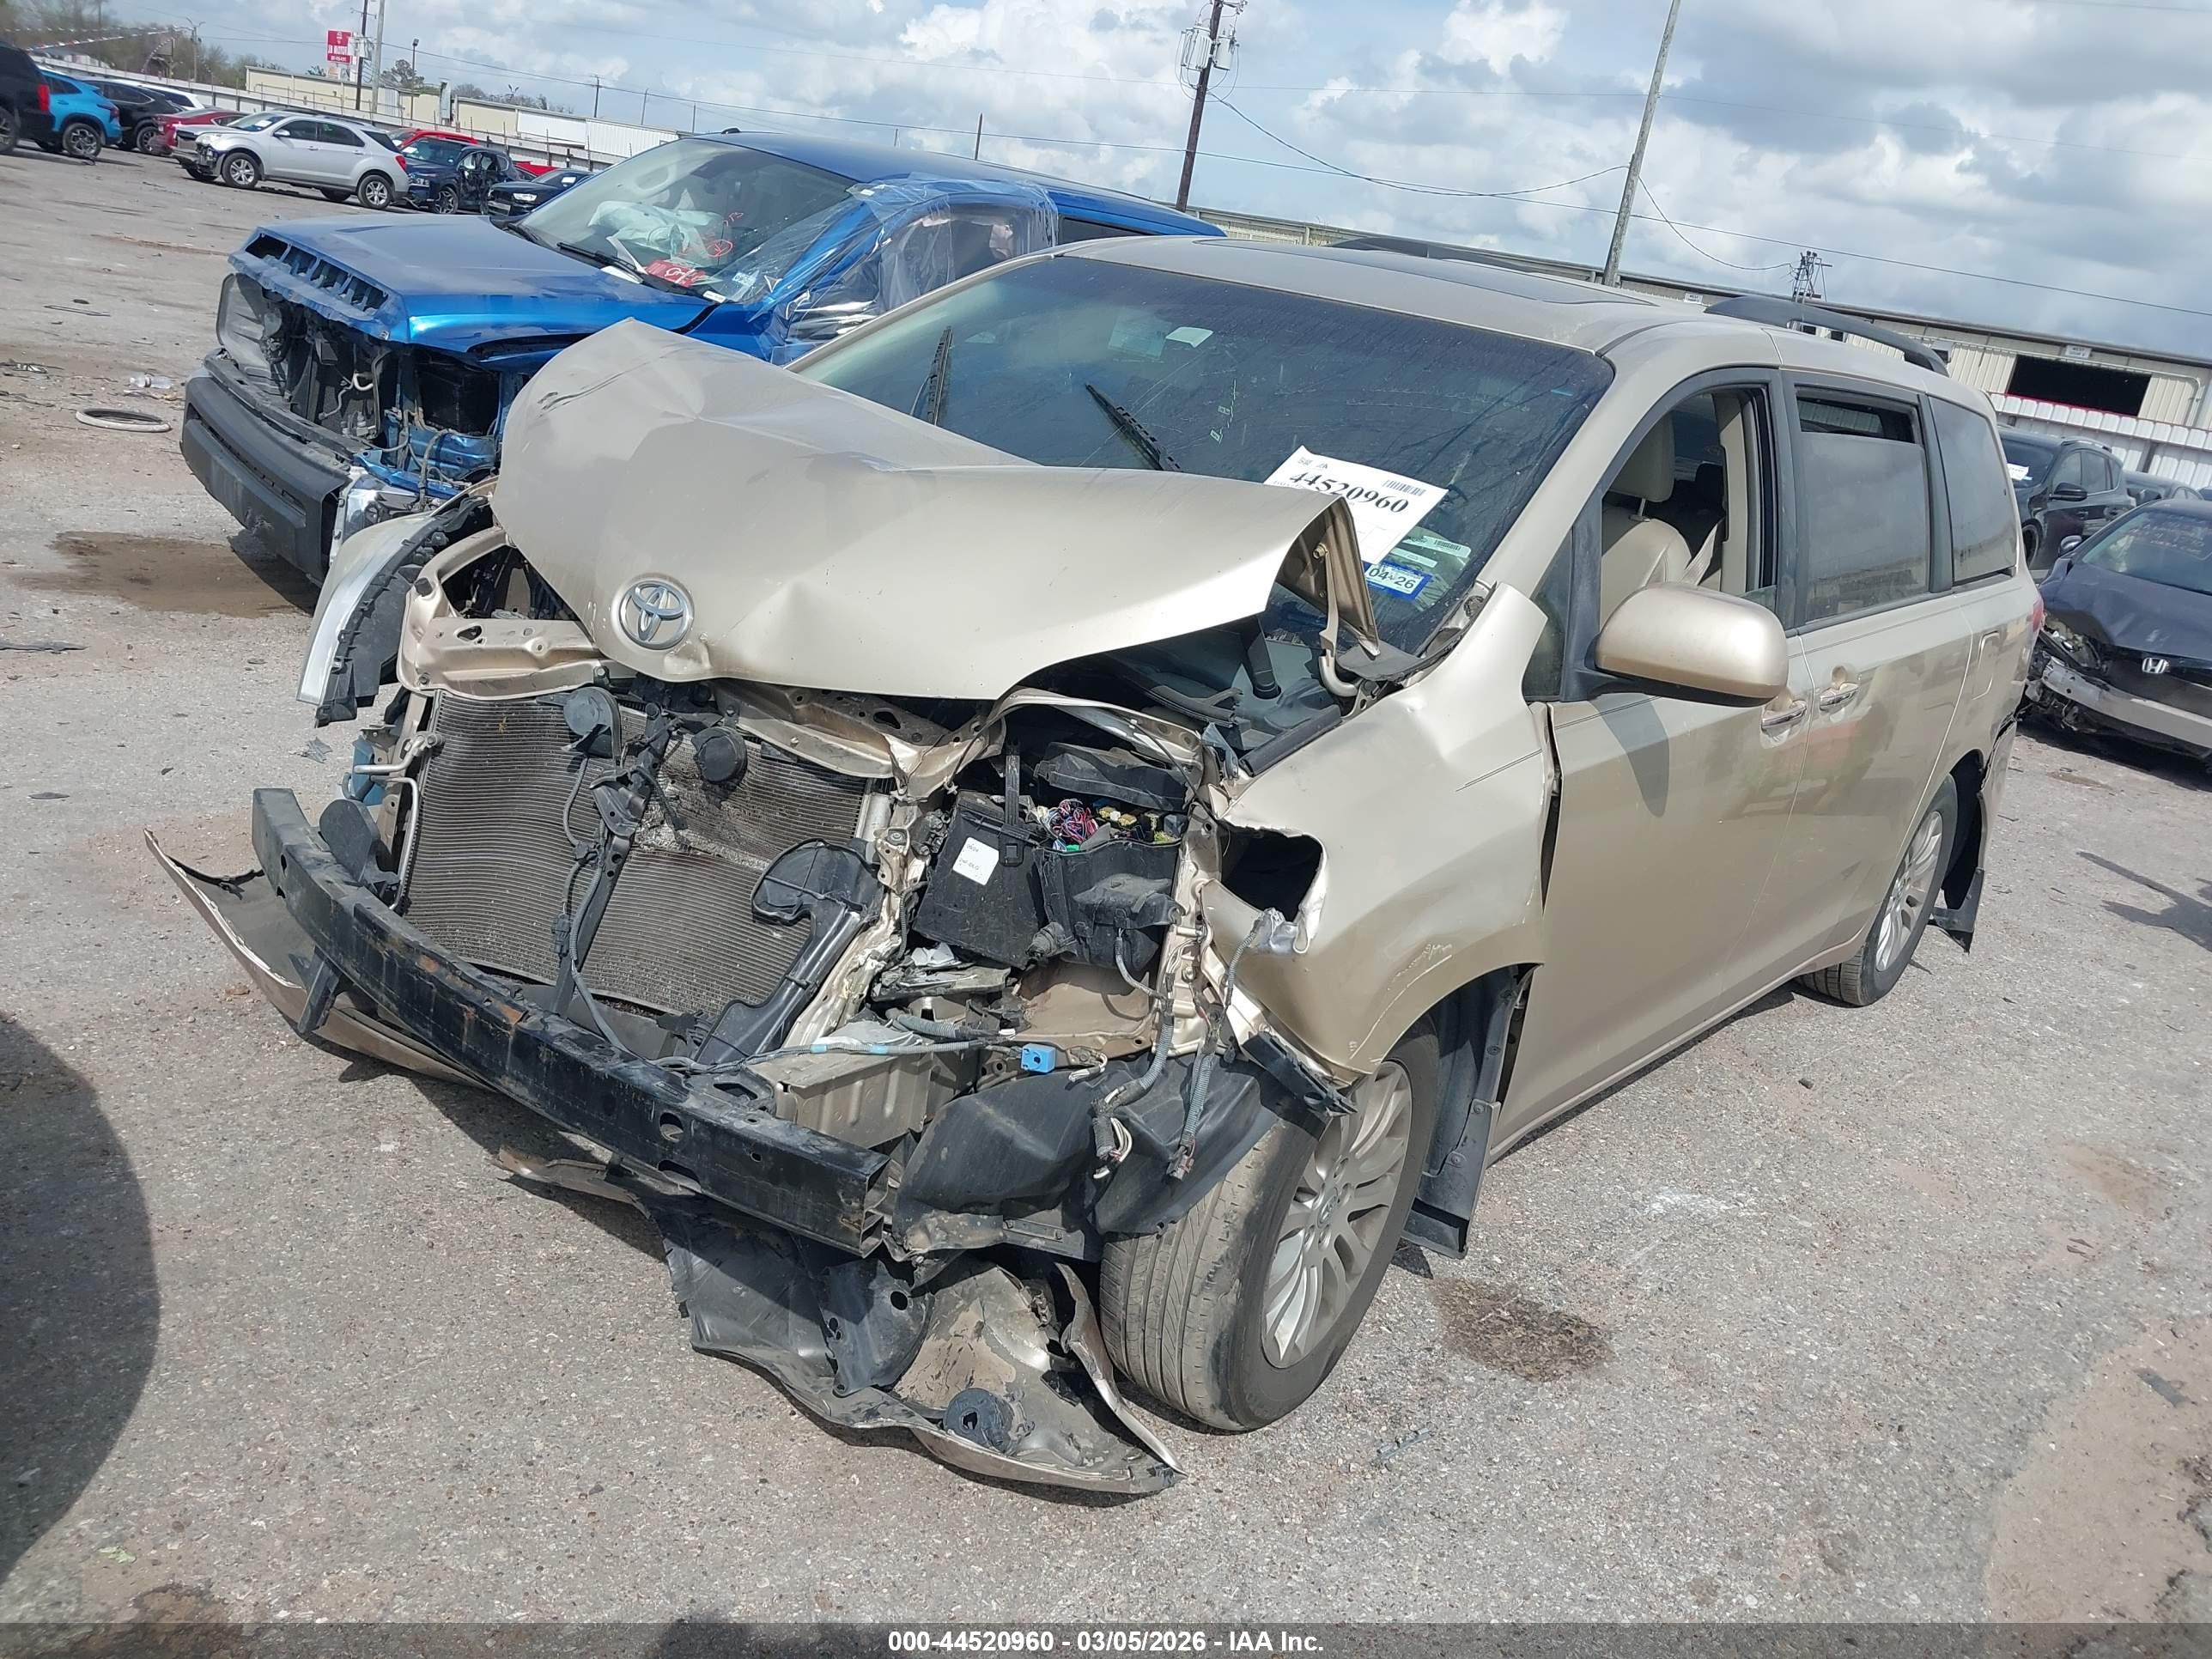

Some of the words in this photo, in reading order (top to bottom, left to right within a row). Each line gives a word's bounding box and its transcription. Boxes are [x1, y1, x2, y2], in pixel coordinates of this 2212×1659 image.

[1289, 472, 1409, 513] 44520960
[1369, 568, 1389, 580] 04
[1395, 576, 1417, 589] 26
